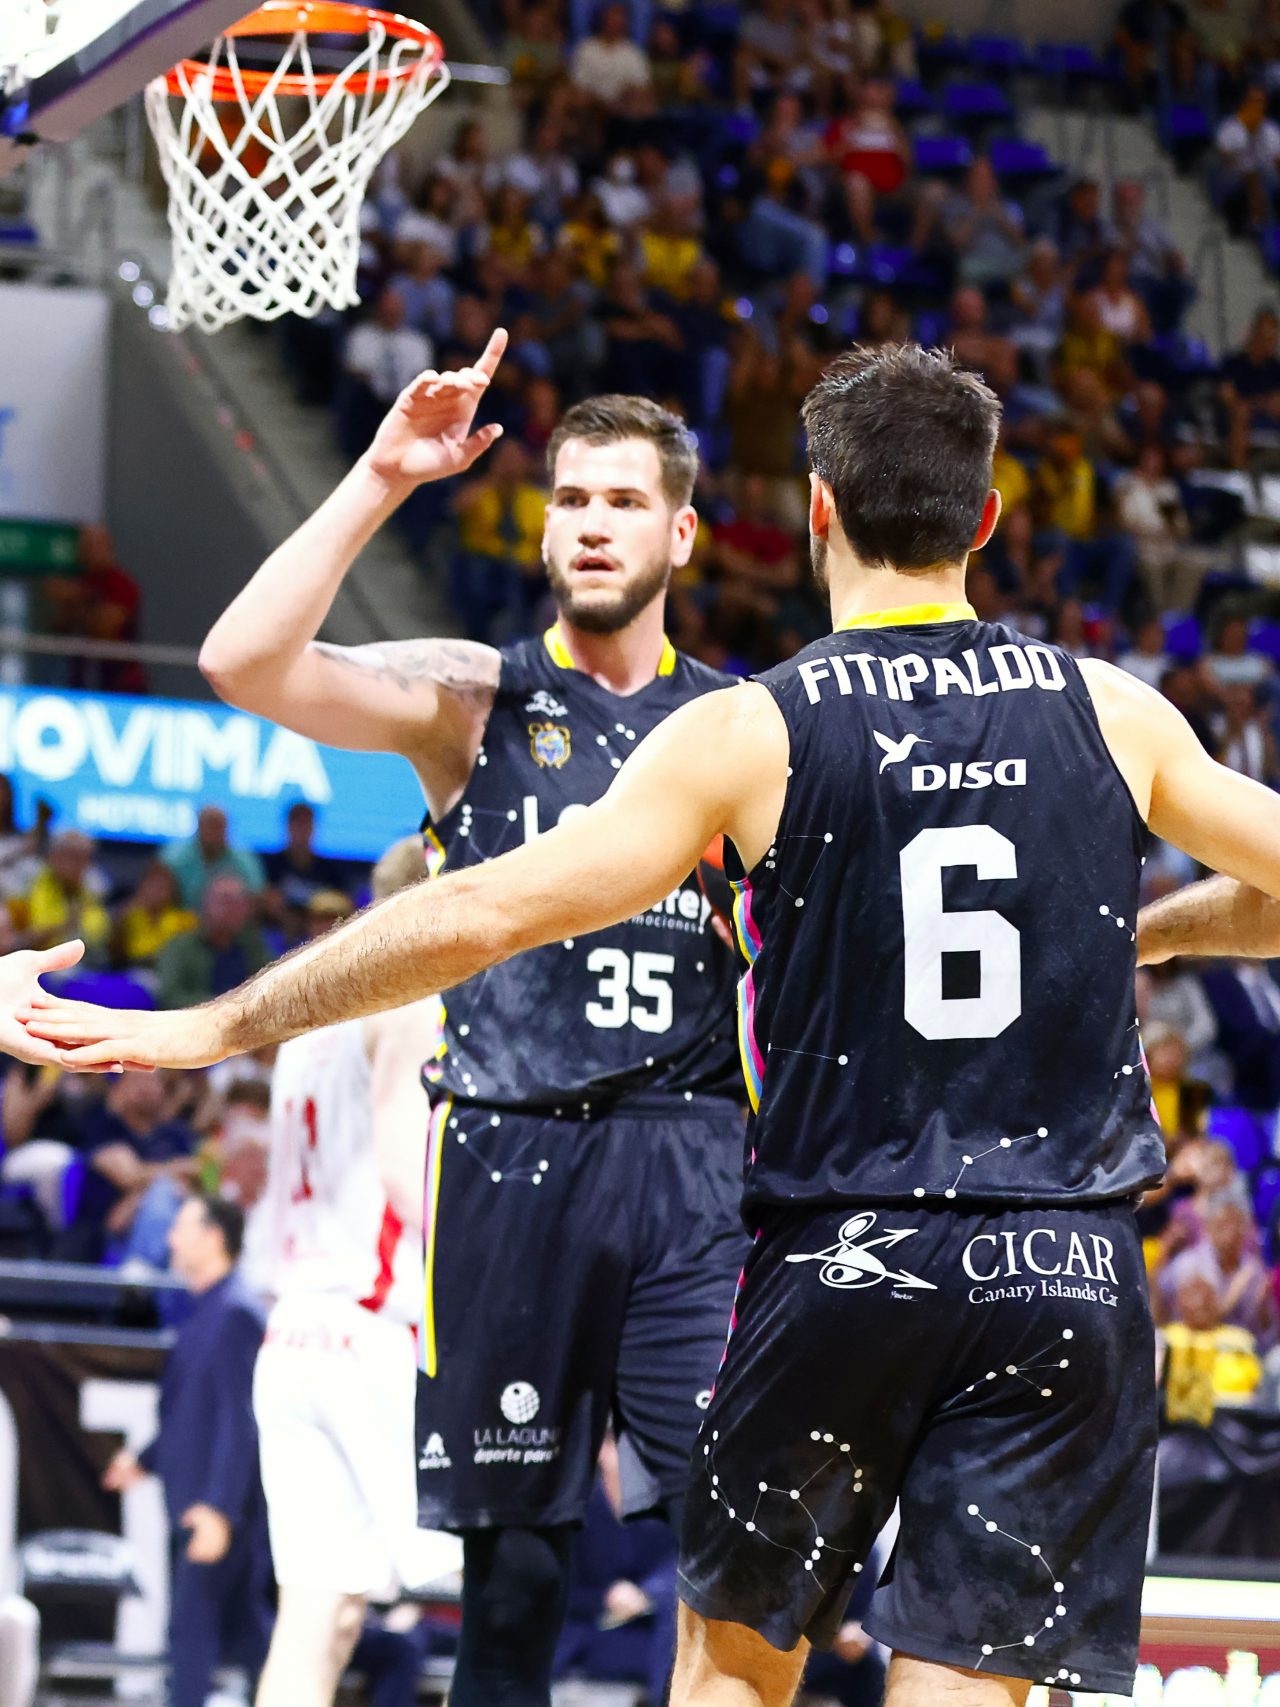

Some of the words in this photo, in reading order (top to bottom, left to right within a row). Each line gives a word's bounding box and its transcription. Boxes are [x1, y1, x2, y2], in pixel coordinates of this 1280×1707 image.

[797, 644, 1067, 705] FITIPALDO
[624, 914, 698, 934] mociones
[899, 824, 1022, 1041] 6
[585, 948, 675, 1035] 35
[962, 1229, 1119, 1285] CICAR
[968, 1285, 1037, 1304] Canary
[1039, 1279, 1098, 1302] Islands
[496, 1427, 556, 1446] LAGUN
